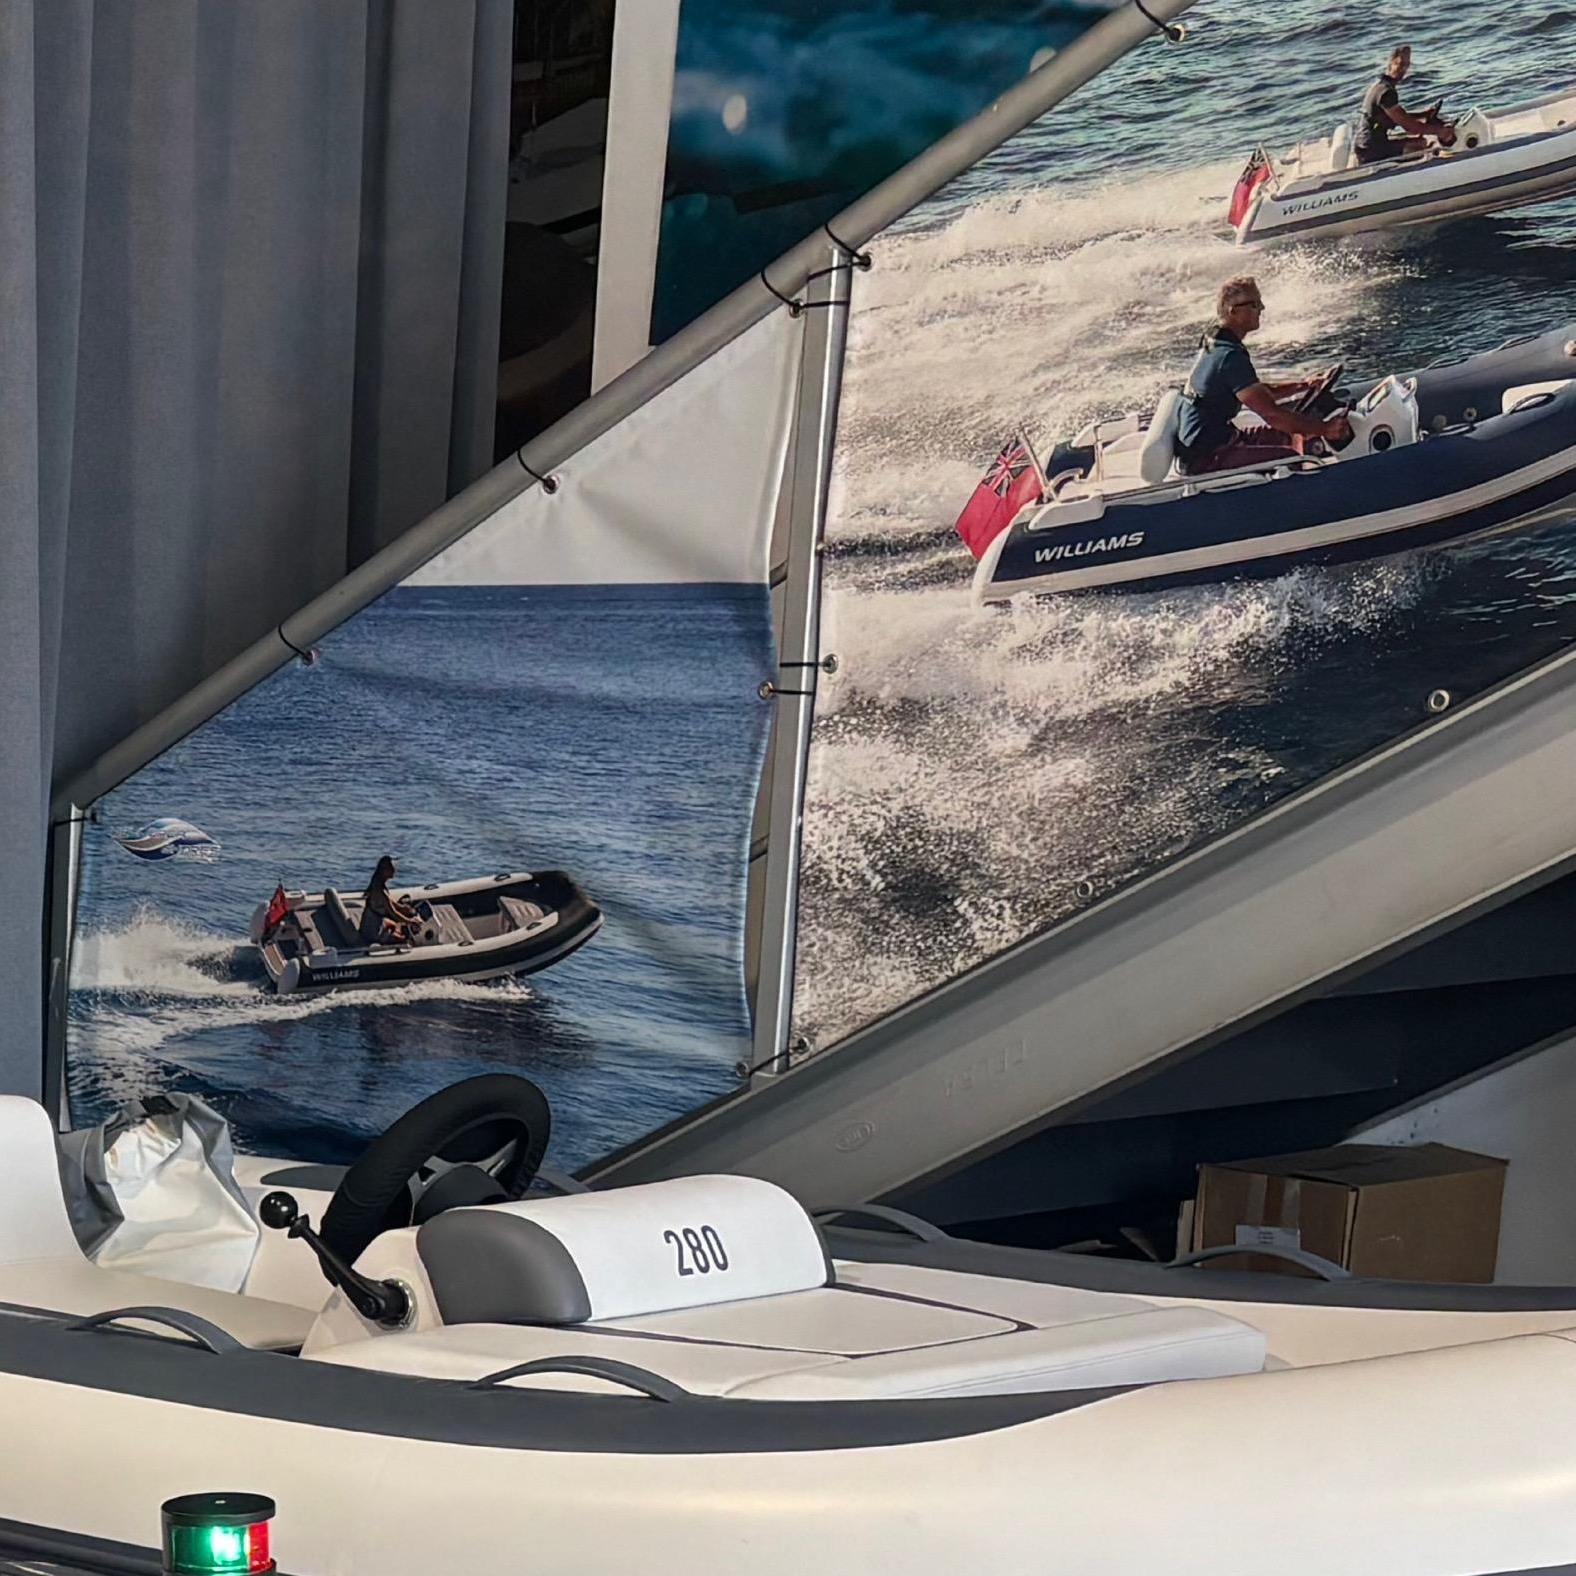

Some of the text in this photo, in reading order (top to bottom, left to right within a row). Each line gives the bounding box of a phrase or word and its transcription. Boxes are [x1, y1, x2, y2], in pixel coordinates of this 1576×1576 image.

[1282, 190, 1359, 216] WILLIAMS
[1034, 531, 1145, 563] WILLIAMS
[663, 1225, 729, 1277] 280
